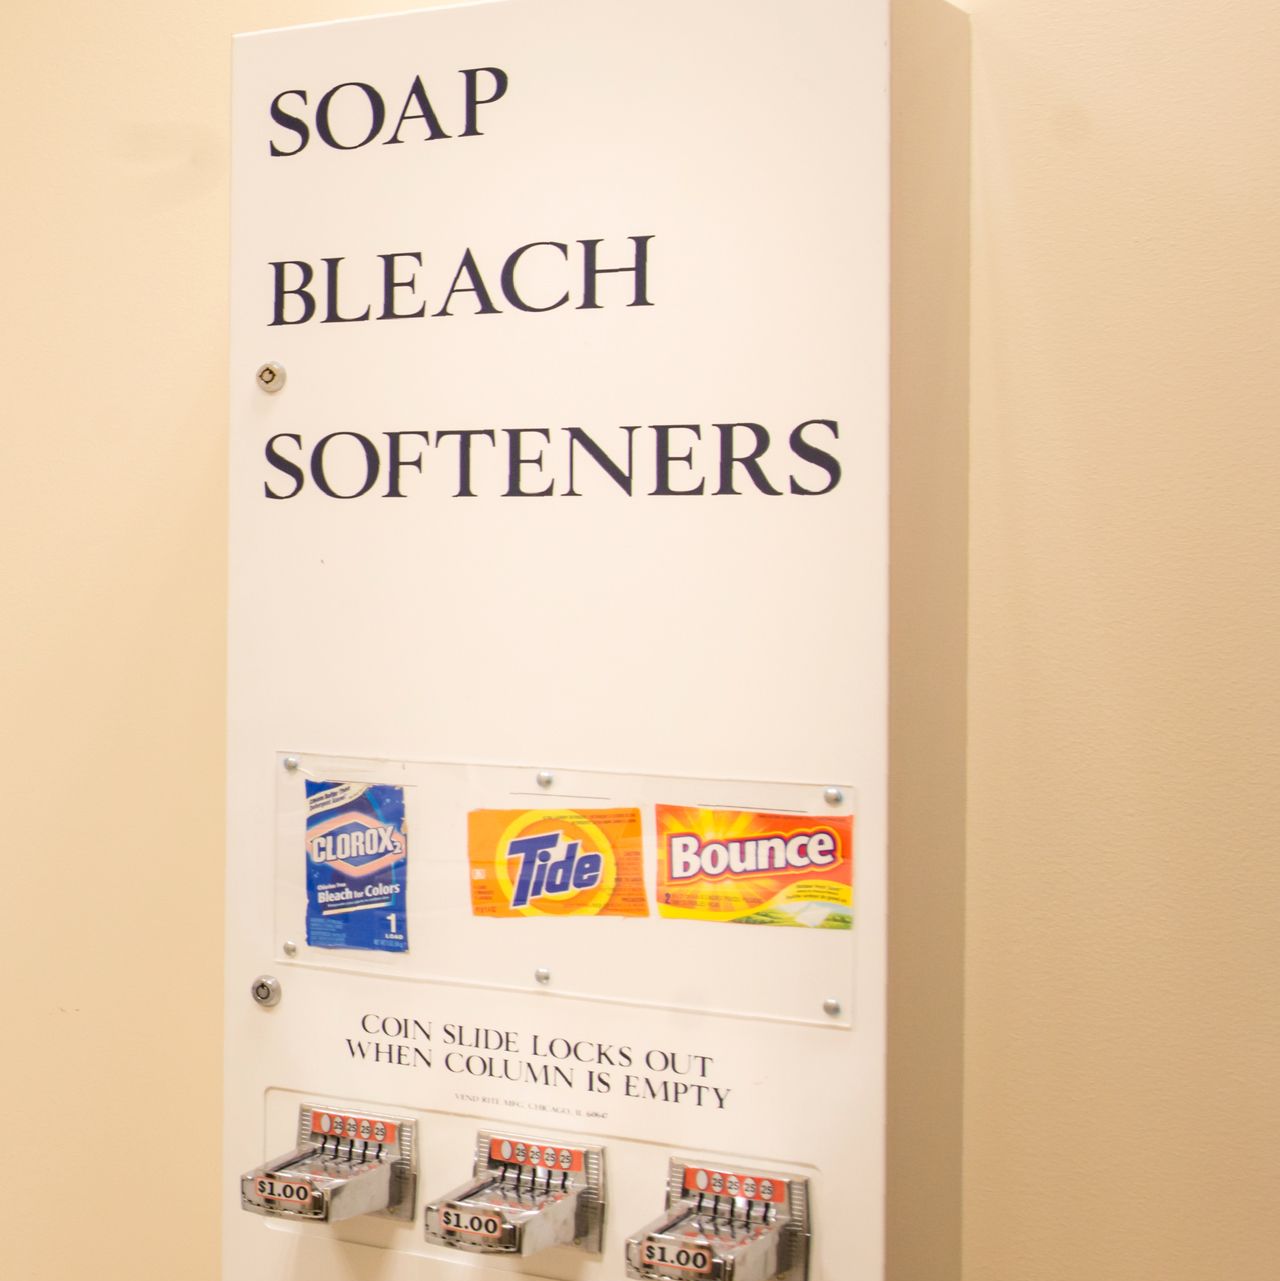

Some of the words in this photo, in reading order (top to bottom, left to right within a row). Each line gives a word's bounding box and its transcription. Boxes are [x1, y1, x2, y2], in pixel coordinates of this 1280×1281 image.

[269, 66, 508, 157] SOAP
[267, 235, 656, 327] BLEACH
[264, 419, 842, 500] SOFTENERS
[671, 833, 835, 879] Bounce
[507, 833, 601, 907] Tide
[318, 888, 352, 903] Bleach
[364, 883, 400, 897] Colors
[386, 913, 396, 933] 1
[361, 1013, 432, 1041] COIN
[443, 1023, 520, 1054] SLIDE
[531, 1034, 633, 1068] LOCKS
[645, 1049, 714, 1079] OUT
[345, 1038, 433, 1068] WHEN
[444, 1051, 575, 1089] COLUMN
[587, 1070, 611, 1093] IS
[625, 1075, 732, 1110] EMPTY
[334, 1120, 343, 1130] 25
[347, 1123, 357, 1132] 25
[361, 1124, 370, 1134] 25
[375, 1127, 384, 1137] 25
[516, 1148, 526, 1157] 25
[531, 1151, 540, 1161] 25
[545, 1152, 555, 1161] 25
[560, 1154, 571, 1164] 25
[712, 1178, 722, 1187] 25
[728, 1180, 739, 1189] 25
[744, 1182, 755, 1192] 25
[761, 1184, 773, 1194] 25
[258, 1180, 308, 1201] $1.00
[443, 1211, 498, 1234] $1.00
[646, 1245, 707, 1269] $1.00
